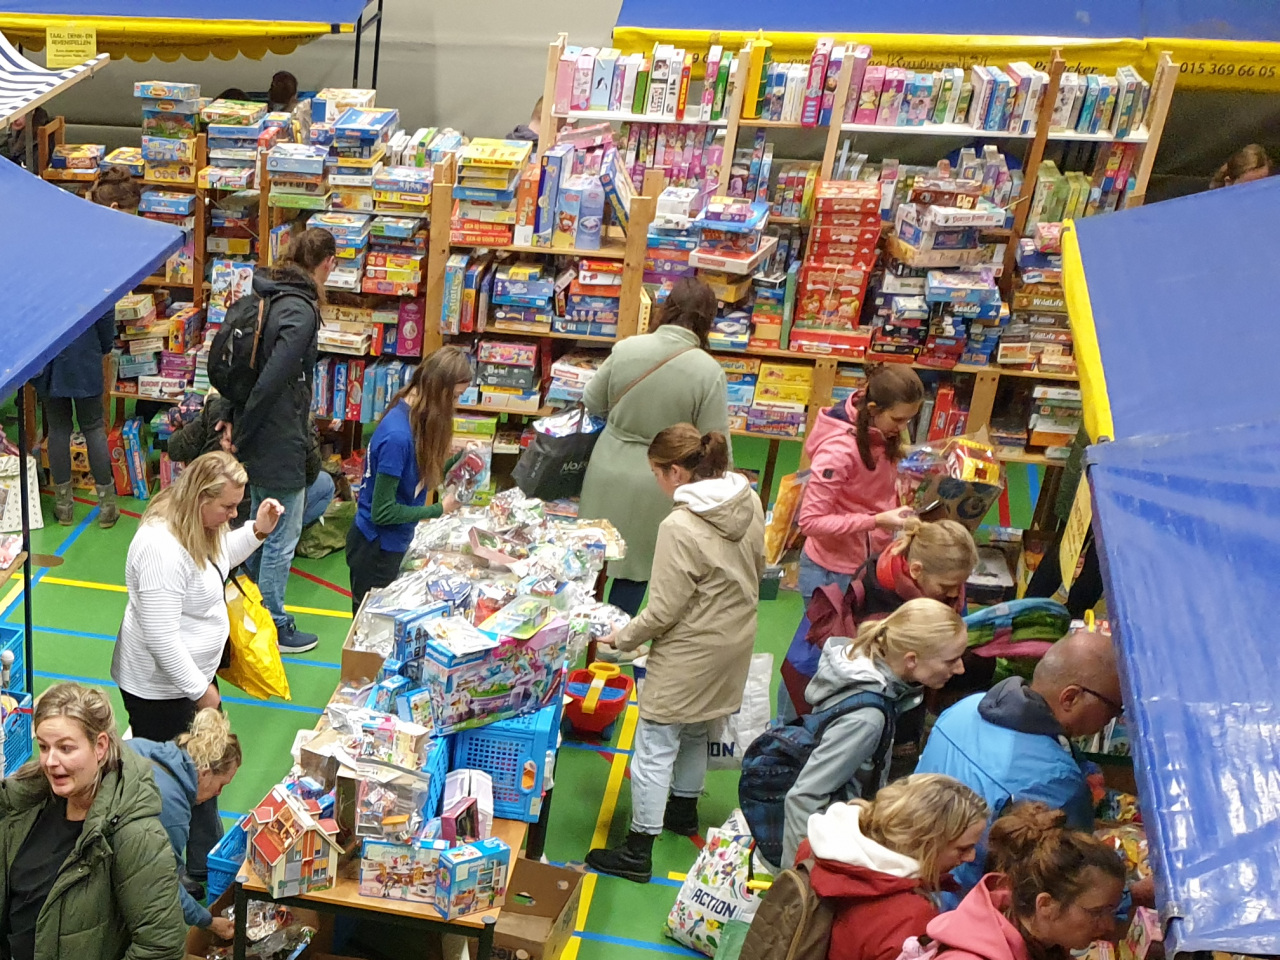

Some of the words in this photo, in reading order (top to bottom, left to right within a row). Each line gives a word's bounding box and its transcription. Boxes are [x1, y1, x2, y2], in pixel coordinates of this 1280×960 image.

[1179, 61, 1205, 74] 015
[1208, 62, 1235, 75] 369
[1237, 64, 1256, 77] 66
[1258, 66, 1276, 78] 05
[692, 888, 738, 918] ACTION
